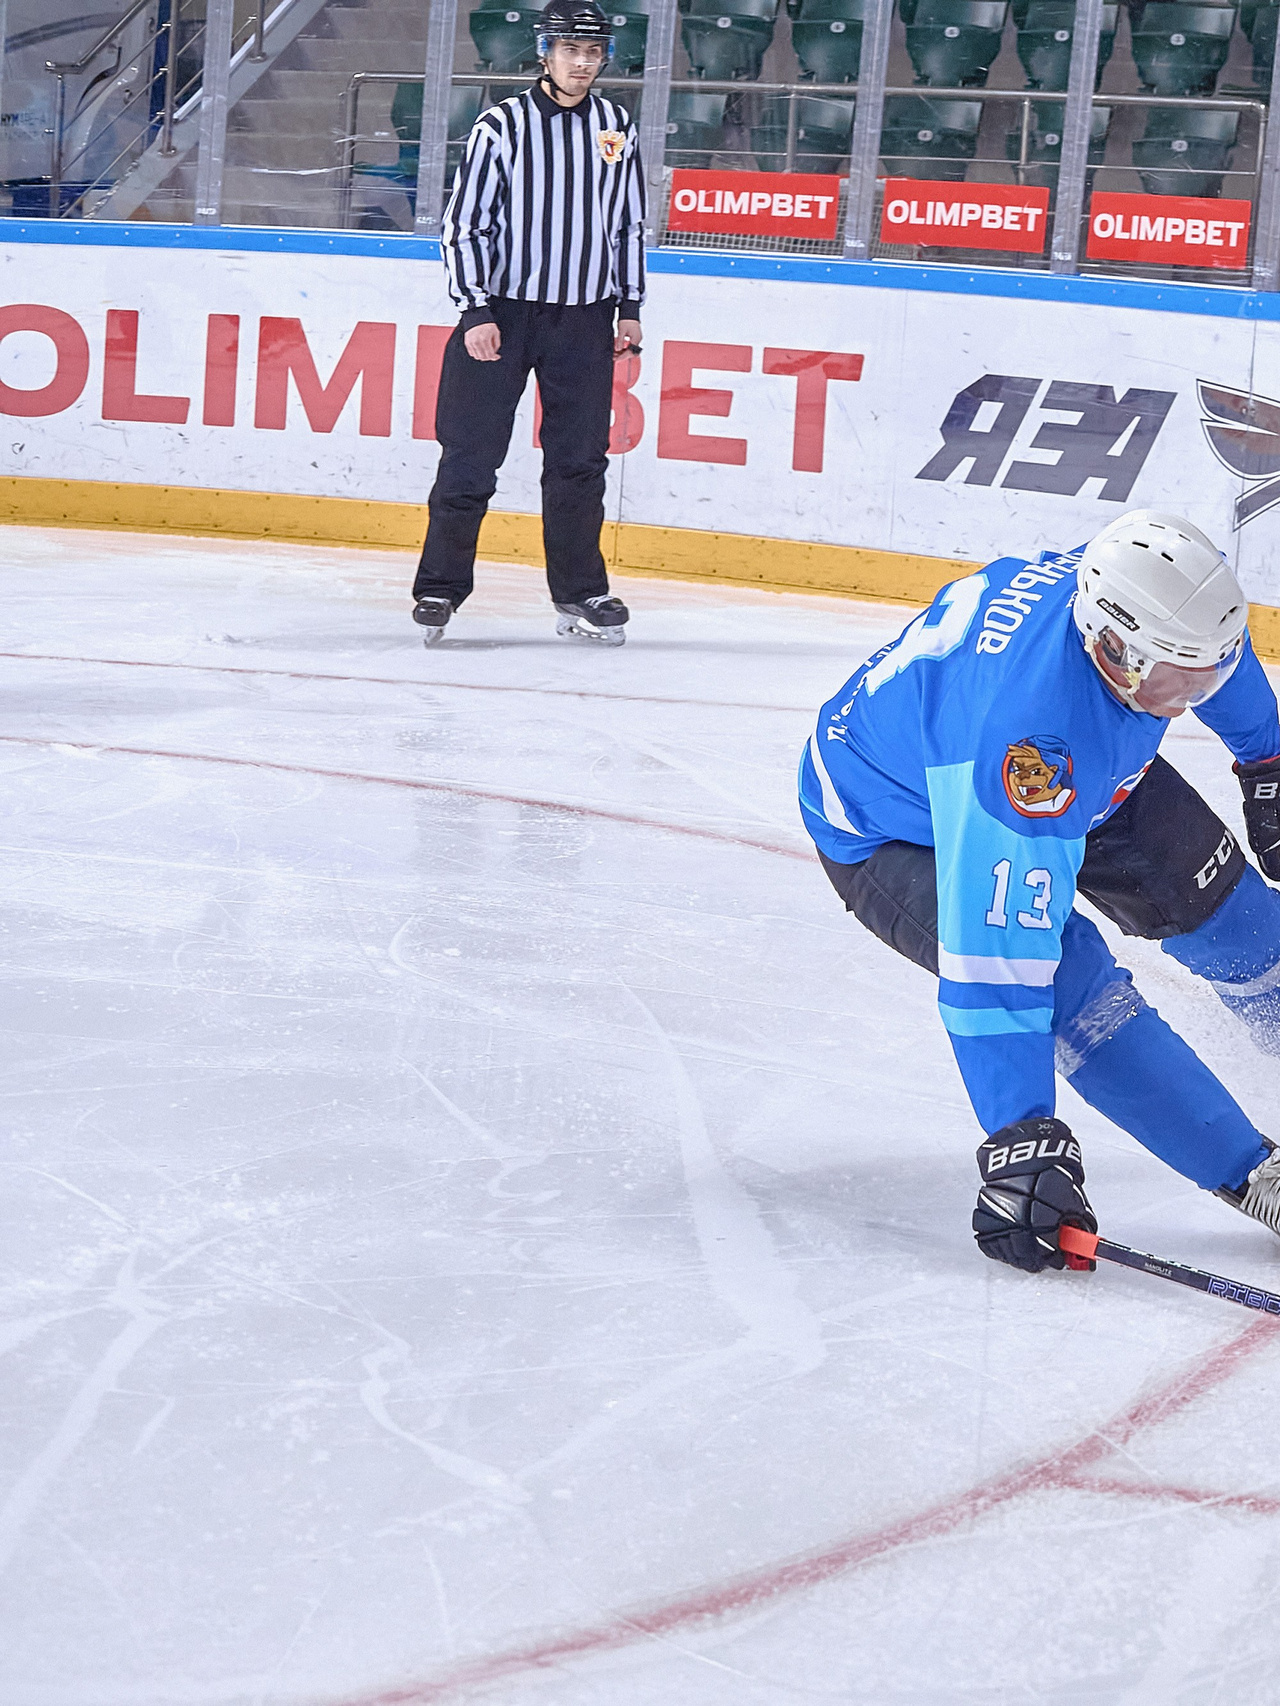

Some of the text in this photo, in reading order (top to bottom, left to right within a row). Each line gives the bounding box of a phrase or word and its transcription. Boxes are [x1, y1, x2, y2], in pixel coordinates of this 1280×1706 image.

[675, 189, 834, 219] OLIMPBET
[887, 200, 1042, 231] OLIMPBET
[1093, 213, 1244, 247] OLIMPBET
[985, 858, 1053, 930] 13
